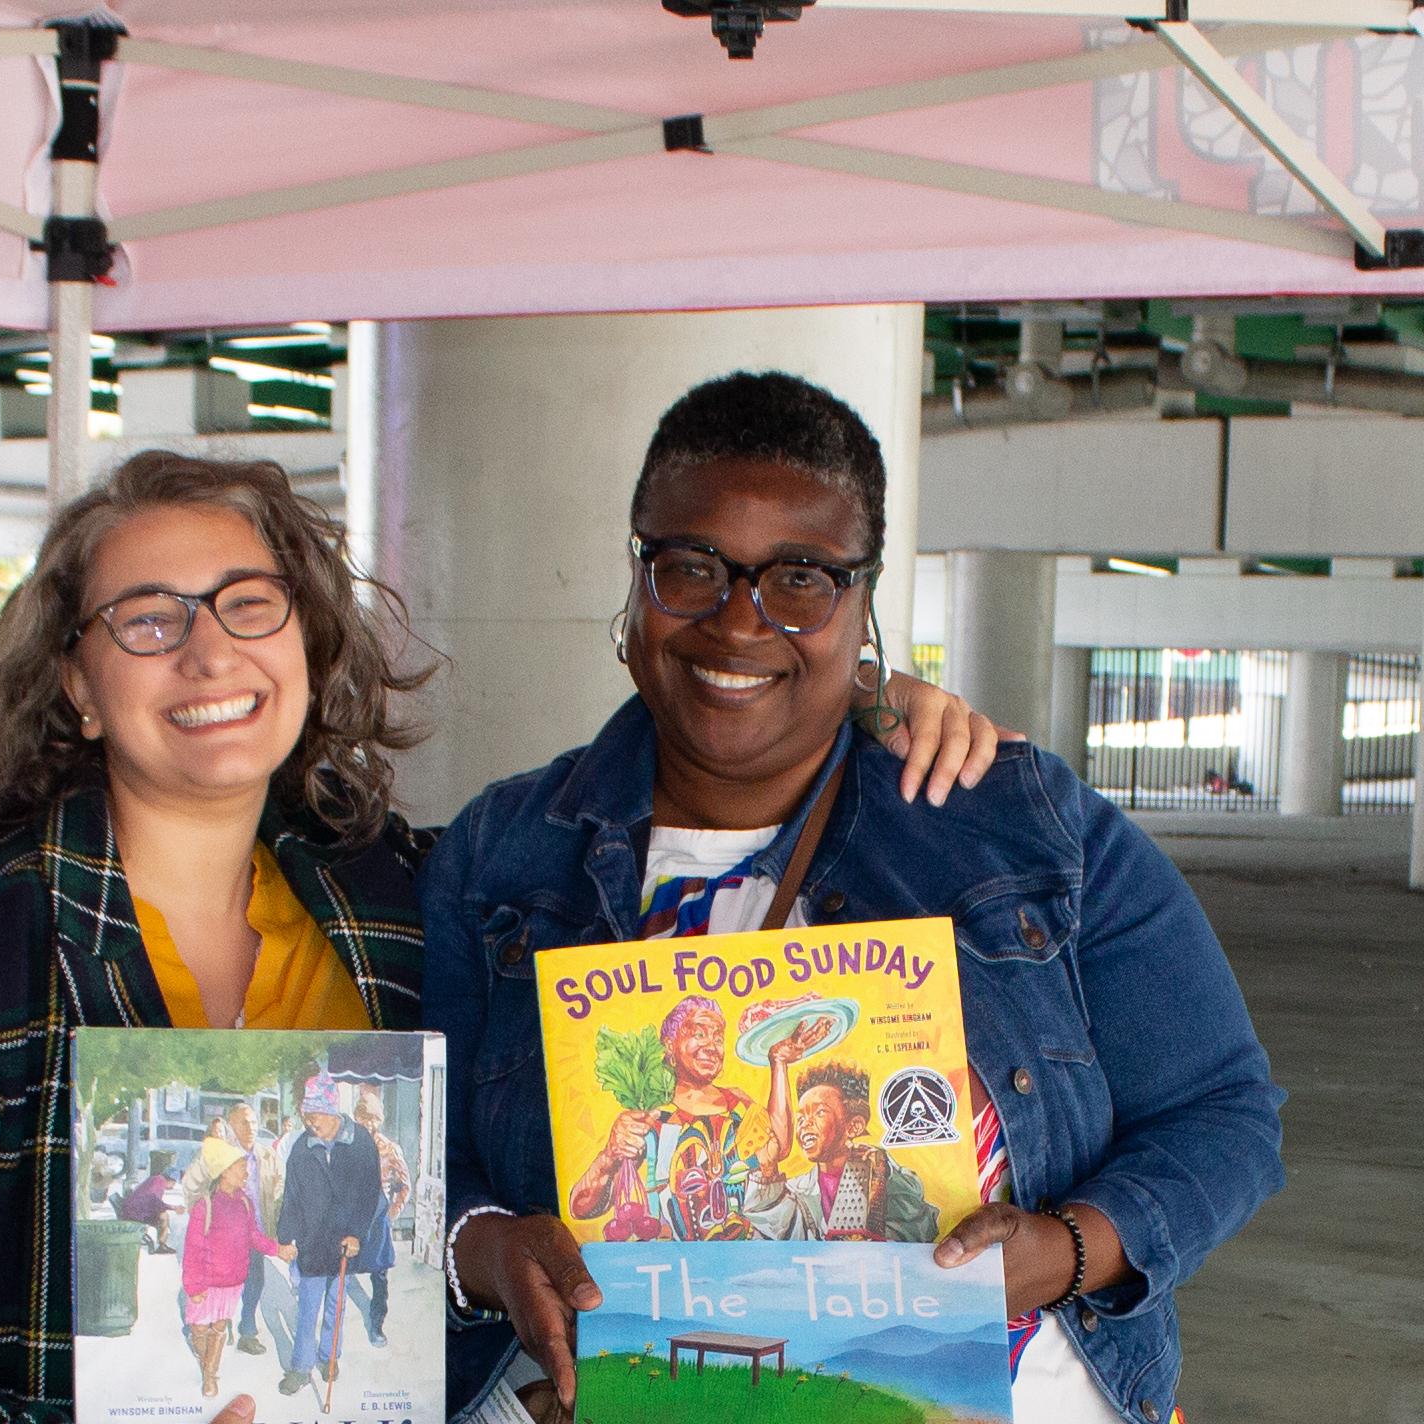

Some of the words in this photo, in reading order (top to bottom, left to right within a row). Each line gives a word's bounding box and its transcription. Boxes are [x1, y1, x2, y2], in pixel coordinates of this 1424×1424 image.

[555, 960, 662, 1020] SOUL
[673, 951, 776, 998] FOOD
[783, 938, 935, 989] SUNDAY
[893, 1041, 930, 1052] ESPERANZA
[636, 1257, 748, 1321] The
[792, 1255, 941, 1322] Table
[136, 1394, 162, 1404] Written
[362, 1390, 394, 1400] Illustrated
[109, 1405, 156, 1417] WINSOME
[158, 1404, 203, 1416] BINGHAM
[383, 1400, 412, 1412] LEWIS
